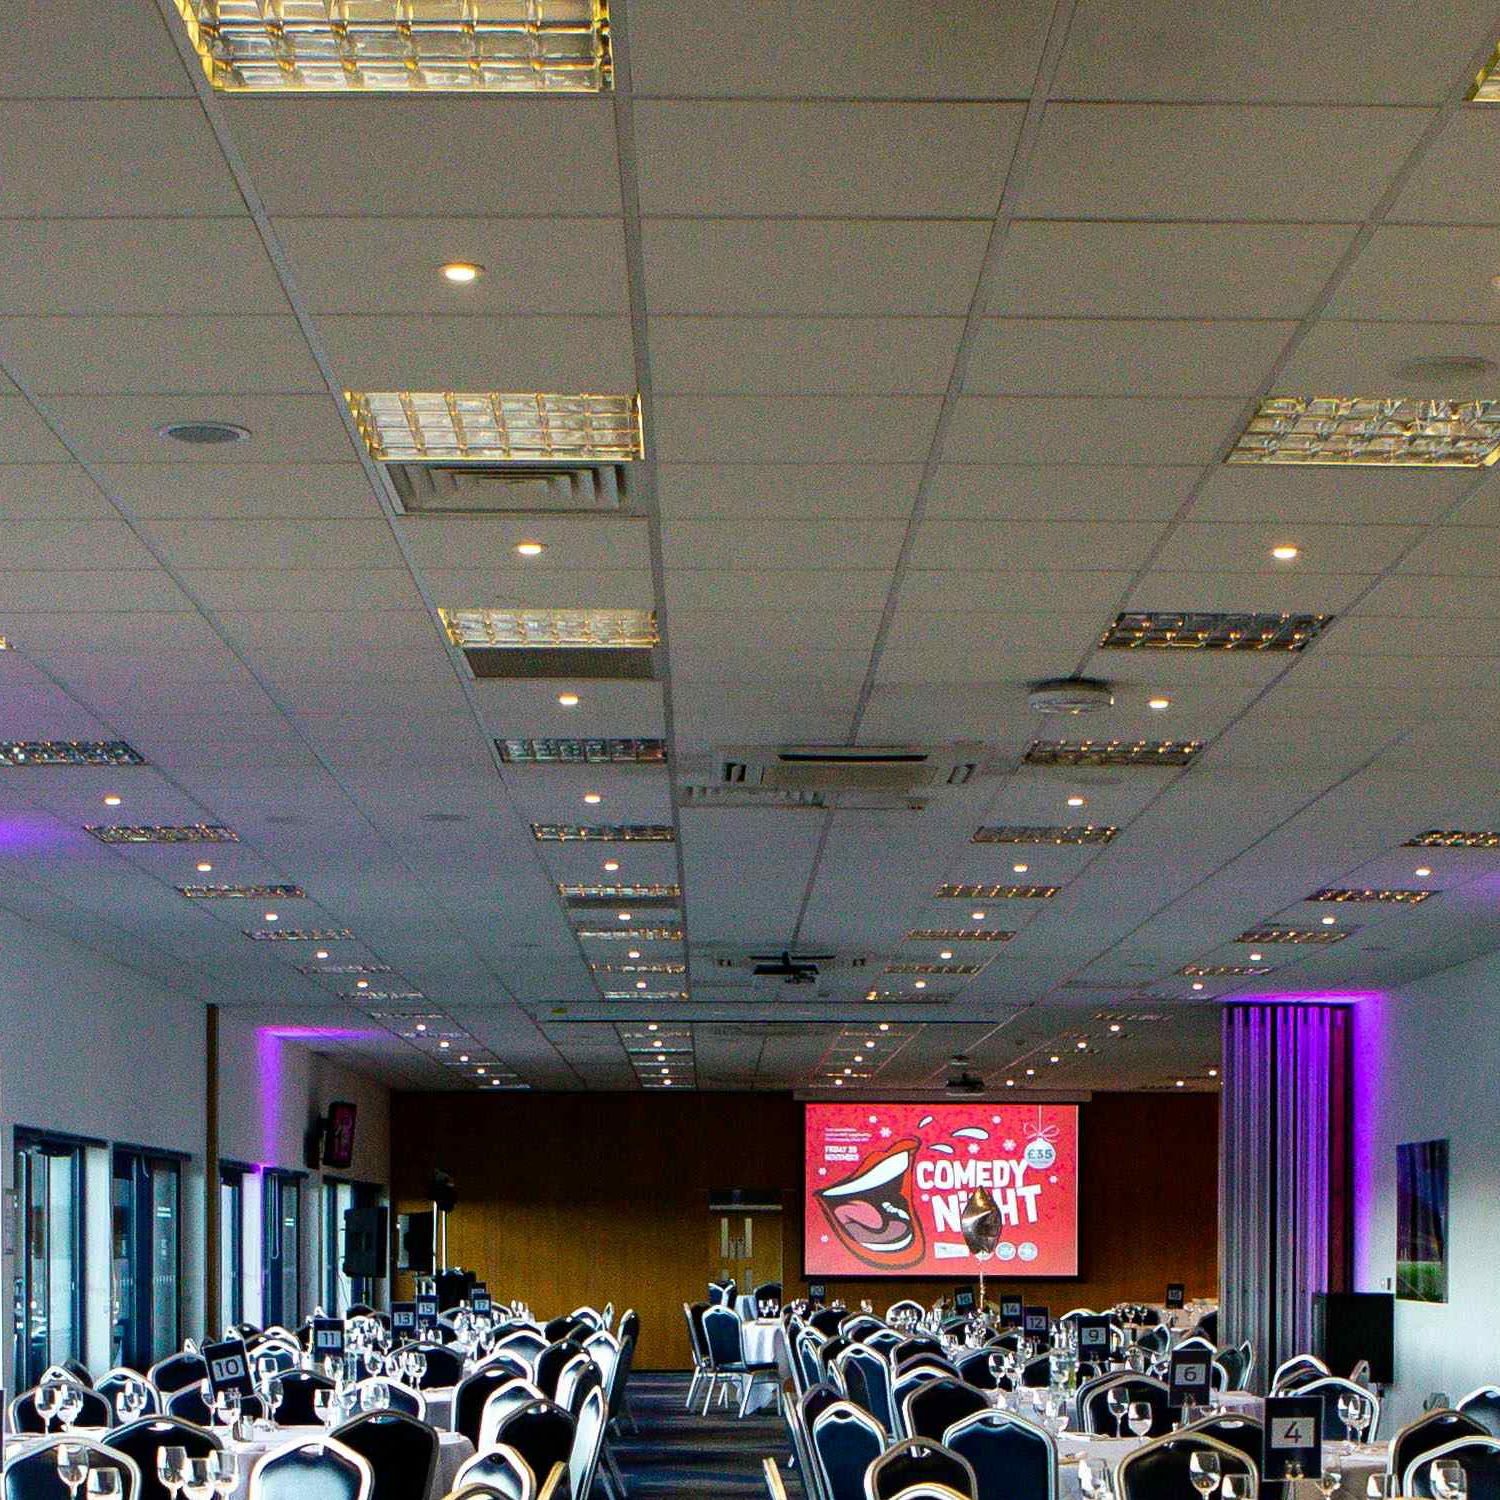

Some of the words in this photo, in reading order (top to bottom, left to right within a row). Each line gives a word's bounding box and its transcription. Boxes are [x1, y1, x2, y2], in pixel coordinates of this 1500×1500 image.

[916, 1159, 1029, 1191] COMEDY
[422, 1303, 433, 1314] 15
[398, 1313, 411, 1325] 13
[1029, 1316, 1043, 1328] 12
[322, 1332, 336, 1345] 11
[1088, 1329, 1099, 1343] 9
[214, 1358, 239, 1376] 10
[1183, 1366, 1197, 1383] 6
[1283, 1421, 1301, 1442] 4
